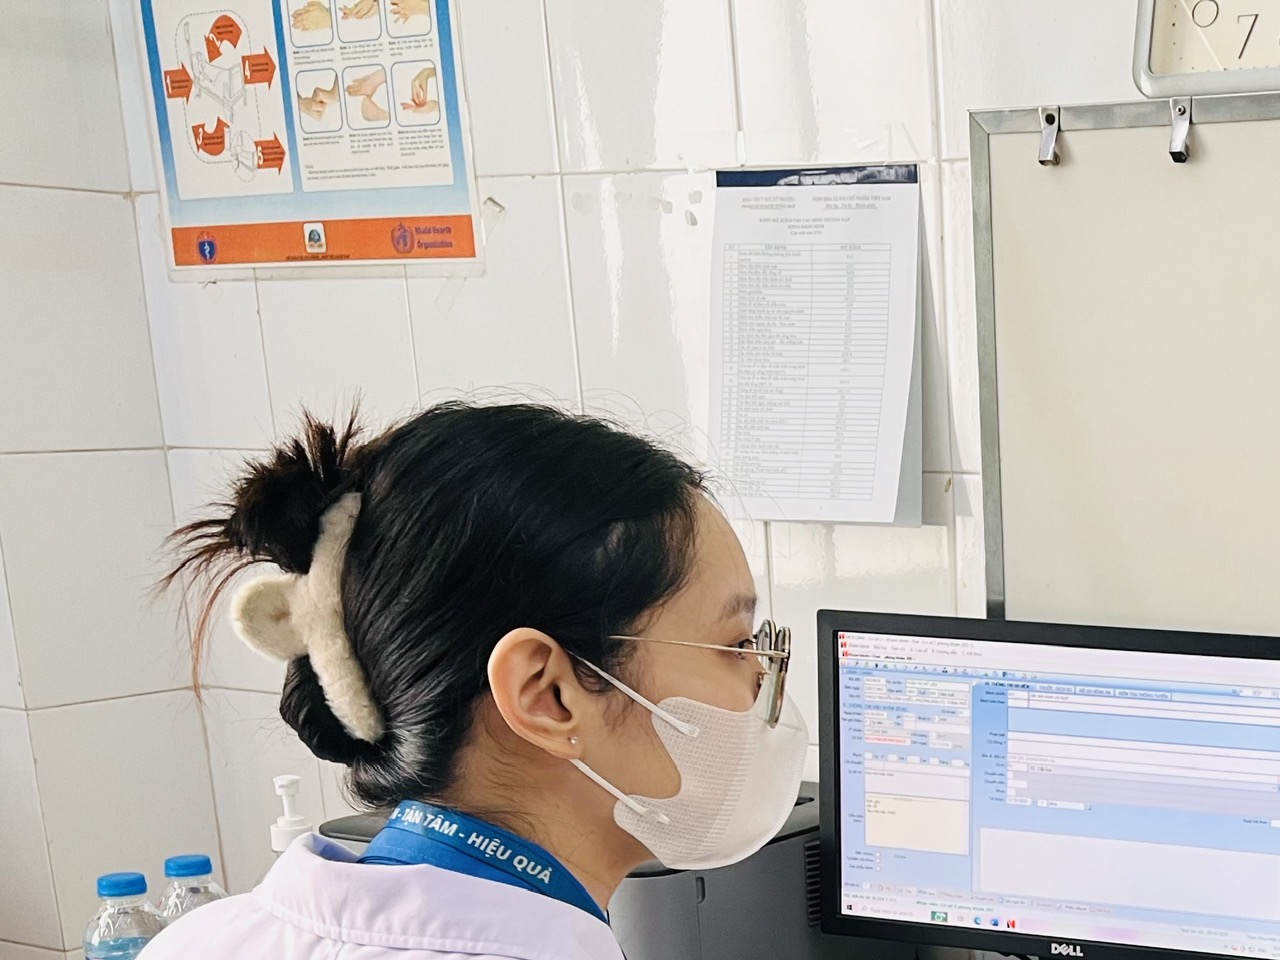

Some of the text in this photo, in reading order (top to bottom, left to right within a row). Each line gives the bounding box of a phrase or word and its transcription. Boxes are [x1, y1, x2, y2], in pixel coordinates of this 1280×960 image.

[209, 33, 221, 47] 2
[1237, 13, 1259, 60] 7
[244, 60, 251, 79] 4
[166, 75, 172, 94] 1
[197, 127, 204, 145] 3
[257, 146, 264, 165] 5
[423, 814, 459, 837] TÂM
[466, 832, 512, 860] HIỆU
[512, 854, 552, 884] QUẢ
[1050, 943, 1084, 958] DELL
